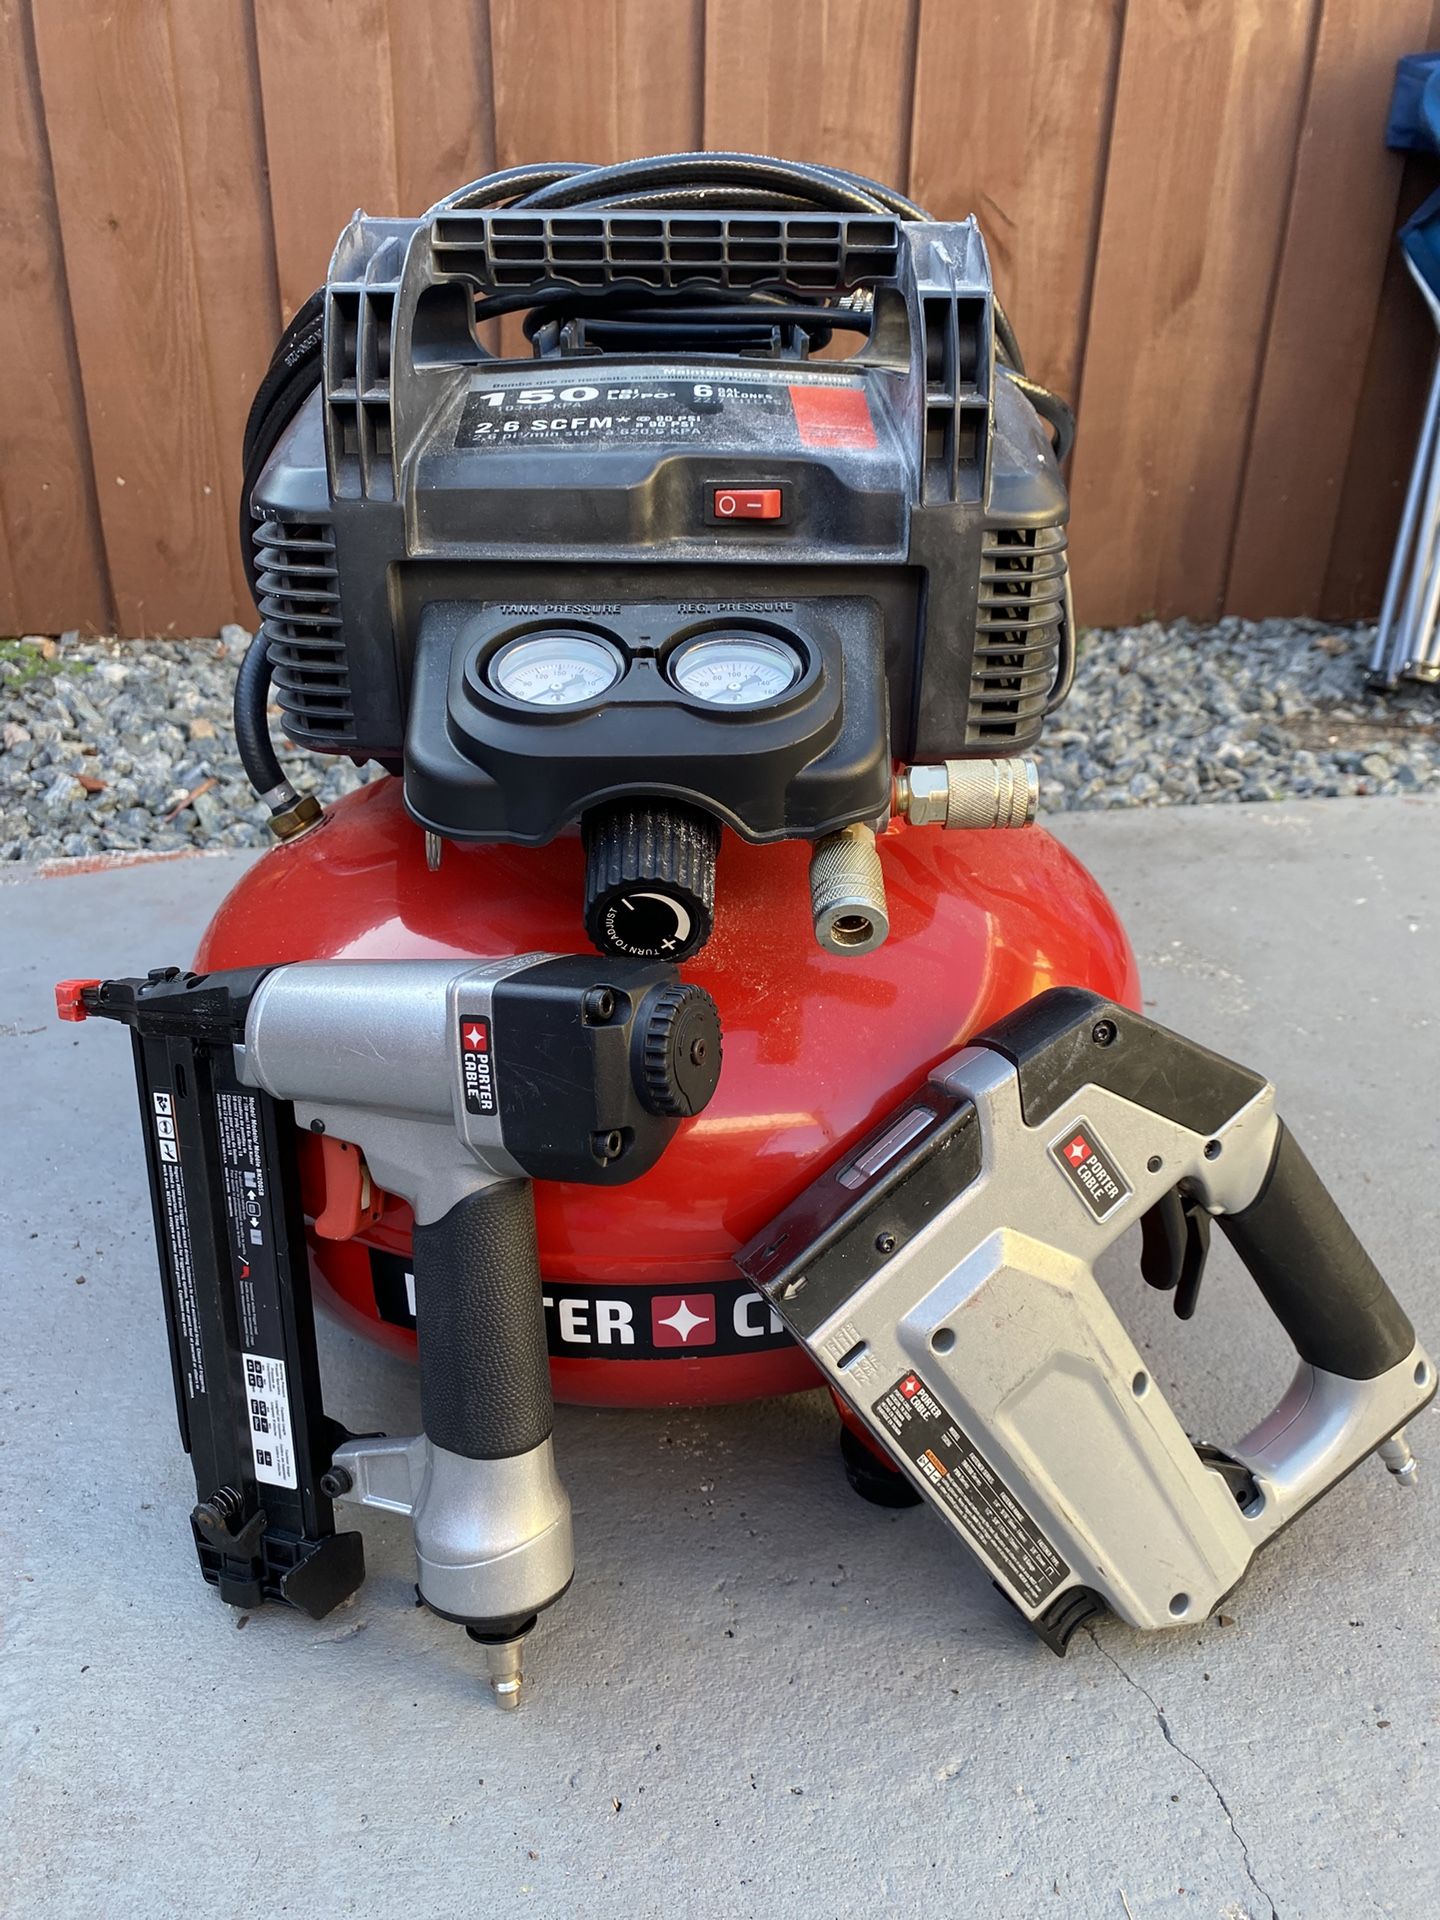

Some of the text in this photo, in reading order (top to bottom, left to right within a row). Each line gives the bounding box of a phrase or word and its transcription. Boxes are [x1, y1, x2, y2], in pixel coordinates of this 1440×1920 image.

[693, 384, 713, 397] 6
[808, 374, 851, 383] Pump
[480, 387, 599, 406] 150
[475, 421, 520, 434] 2.6
[500, 604, 622, 615] TANK PRESSURE
[677, 602, 793, 615] REG. PRESSURE
[605, 906, 660, 956] TURN TO ADJUST
[464, 1053, 478, 1097] CABLE
[477, 1054, 493, 1110] PORTER
[1077, 1165, 1104, 1200] CABLE
[1086, 1155, 1119, 1199] PORTER
[908, 1394, 931, 1421] CABLE
[916, 1387, 942, 1418] PORTER
